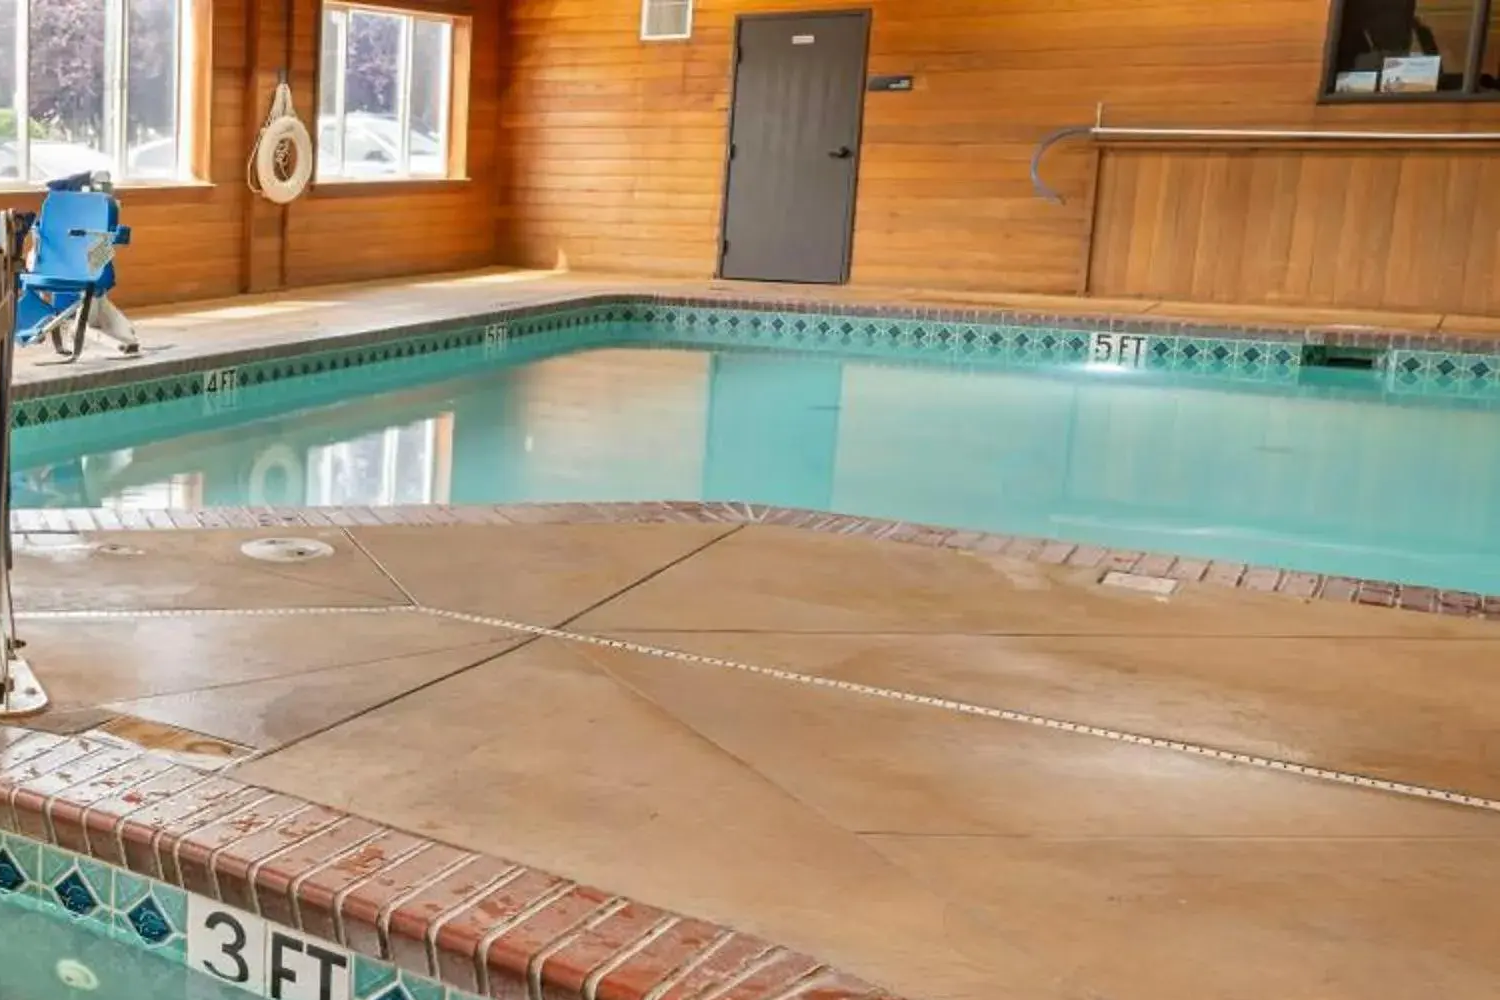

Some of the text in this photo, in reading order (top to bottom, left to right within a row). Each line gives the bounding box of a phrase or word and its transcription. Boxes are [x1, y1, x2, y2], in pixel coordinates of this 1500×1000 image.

[1094, 333, 1146, 369] 5 FT
[206, 368, 237, 393] 4 FT
[203, 910, 249, 983] 3
